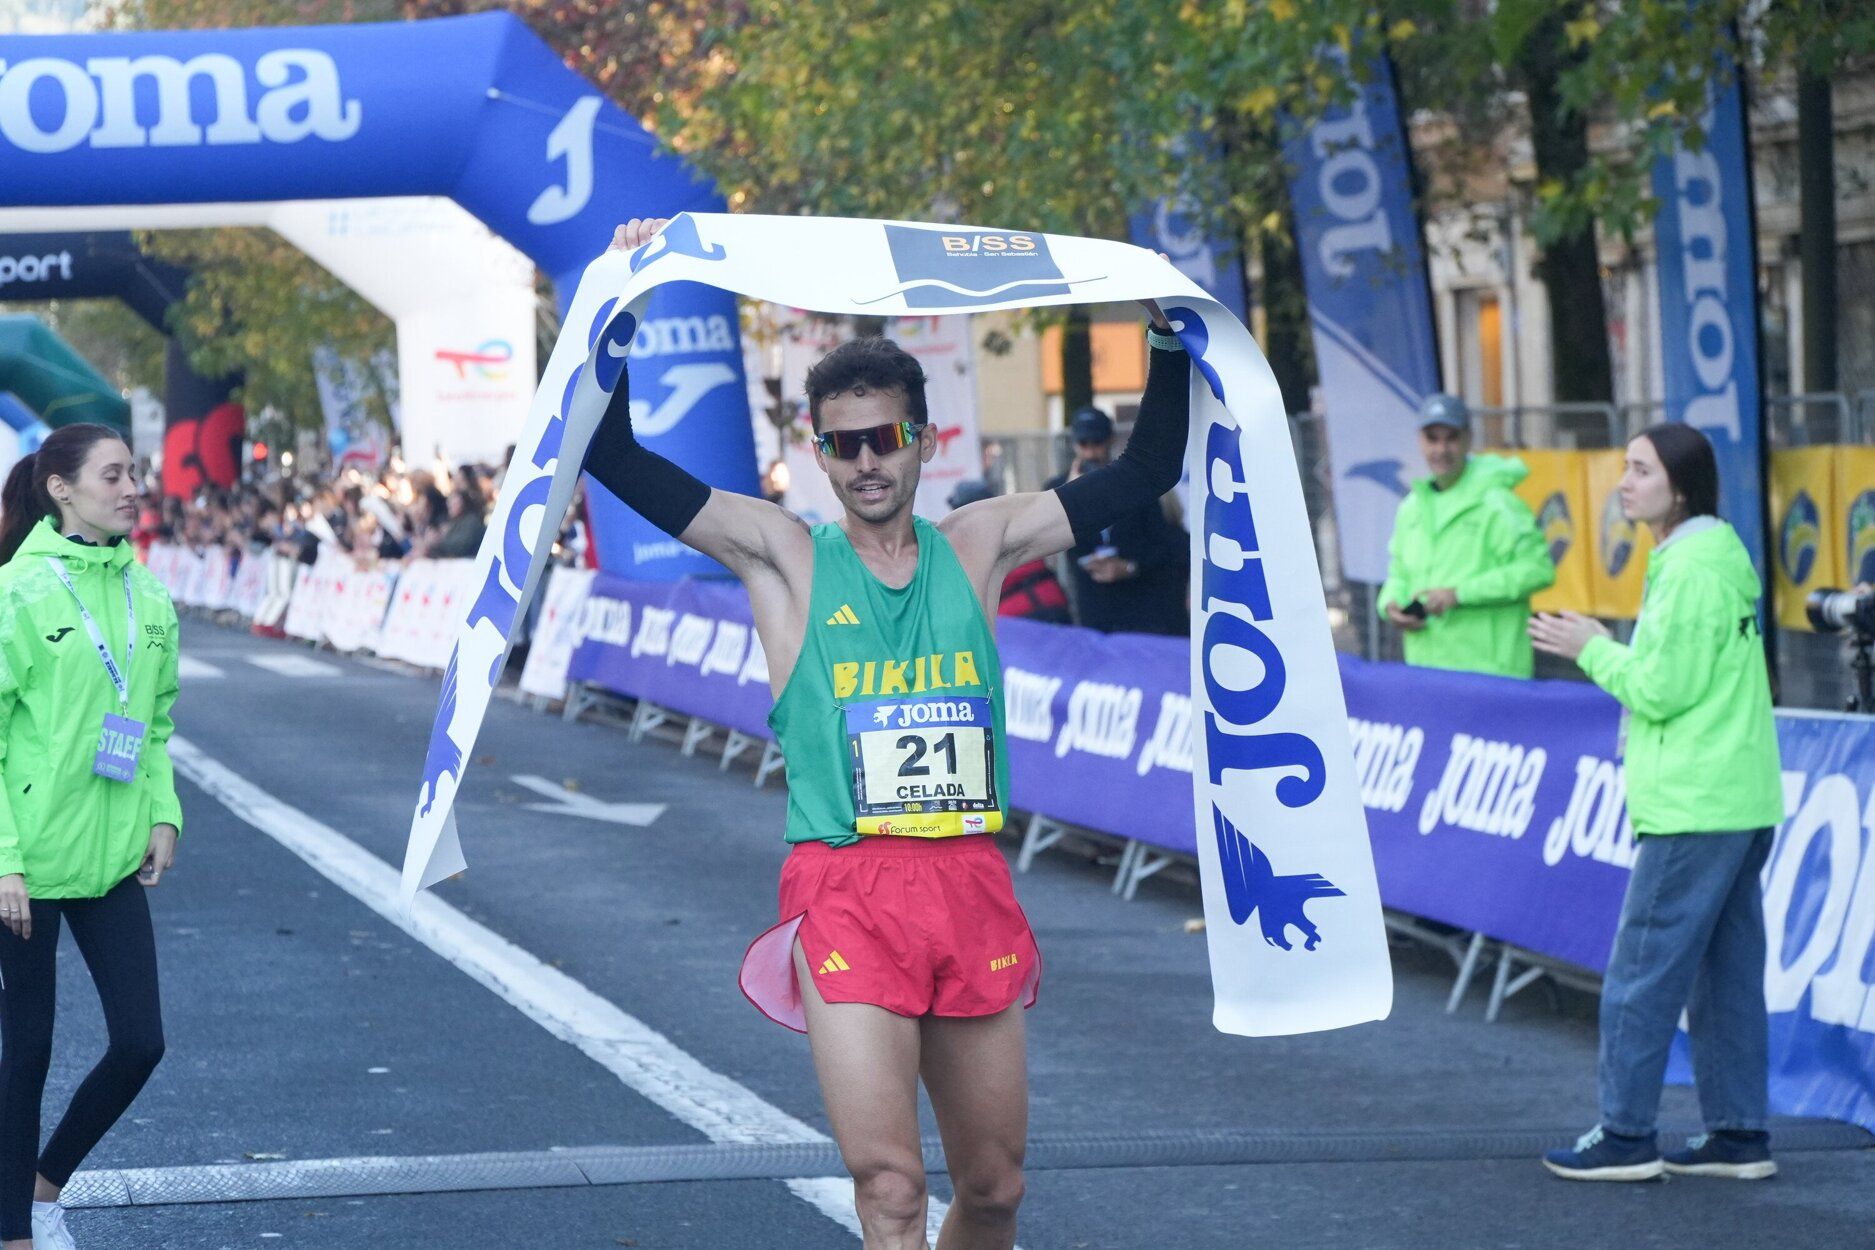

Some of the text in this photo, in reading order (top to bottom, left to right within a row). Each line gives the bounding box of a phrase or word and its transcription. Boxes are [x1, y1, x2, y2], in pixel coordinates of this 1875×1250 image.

[0, 48, 362, 153] oma
[833, 651, 981, 698] BIKILA
[898, 701, 975, 728] Joma
[98, 728, 143, 762] STAFF
[896, 733, 957, 777] 21
[896, 784, 966, 799] CELADA
[1418, 732, 1547, 840] Joma
[919, 824, 941, 834] sport
